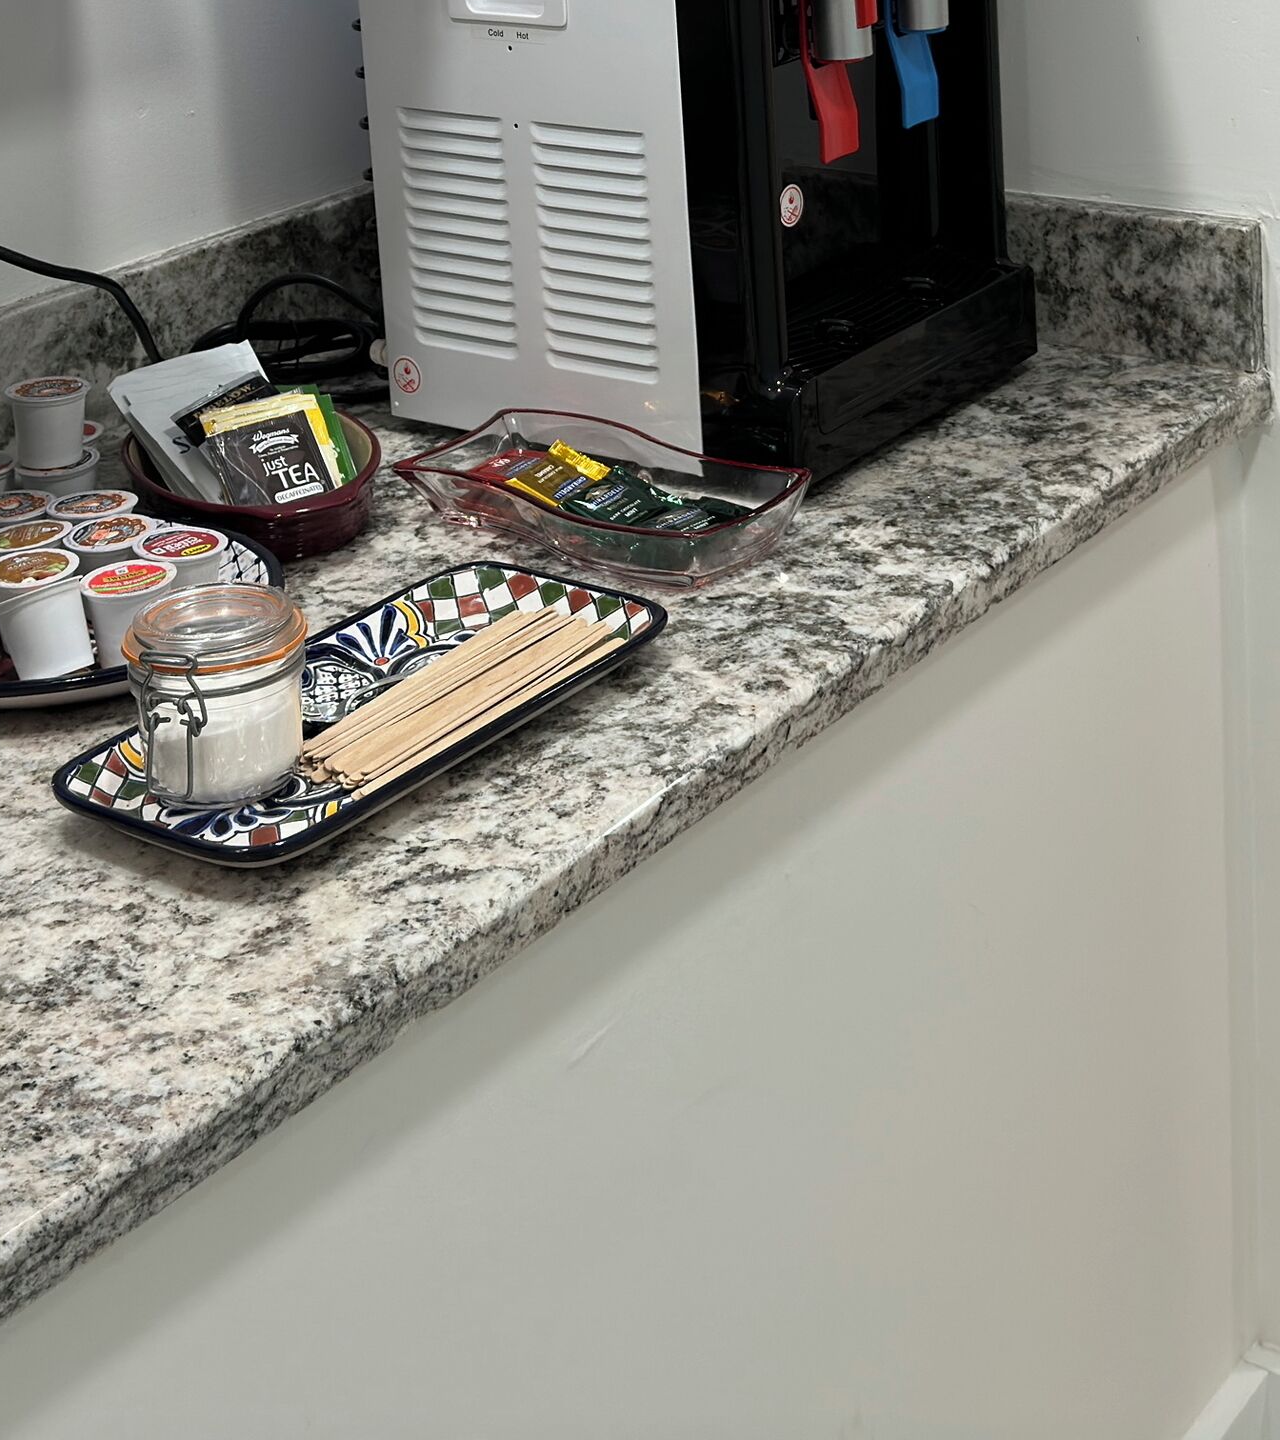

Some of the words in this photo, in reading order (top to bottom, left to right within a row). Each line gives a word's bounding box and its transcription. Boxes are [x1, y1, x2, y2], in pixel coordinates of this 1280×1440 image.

[487, 28, 504, 38] Cold
[516, 31, 529, 41] Hot
[252, 428, 290, 442] Wegmans
[261, 456, 289, 477] just
[271, 462, 320, 489] TEA
